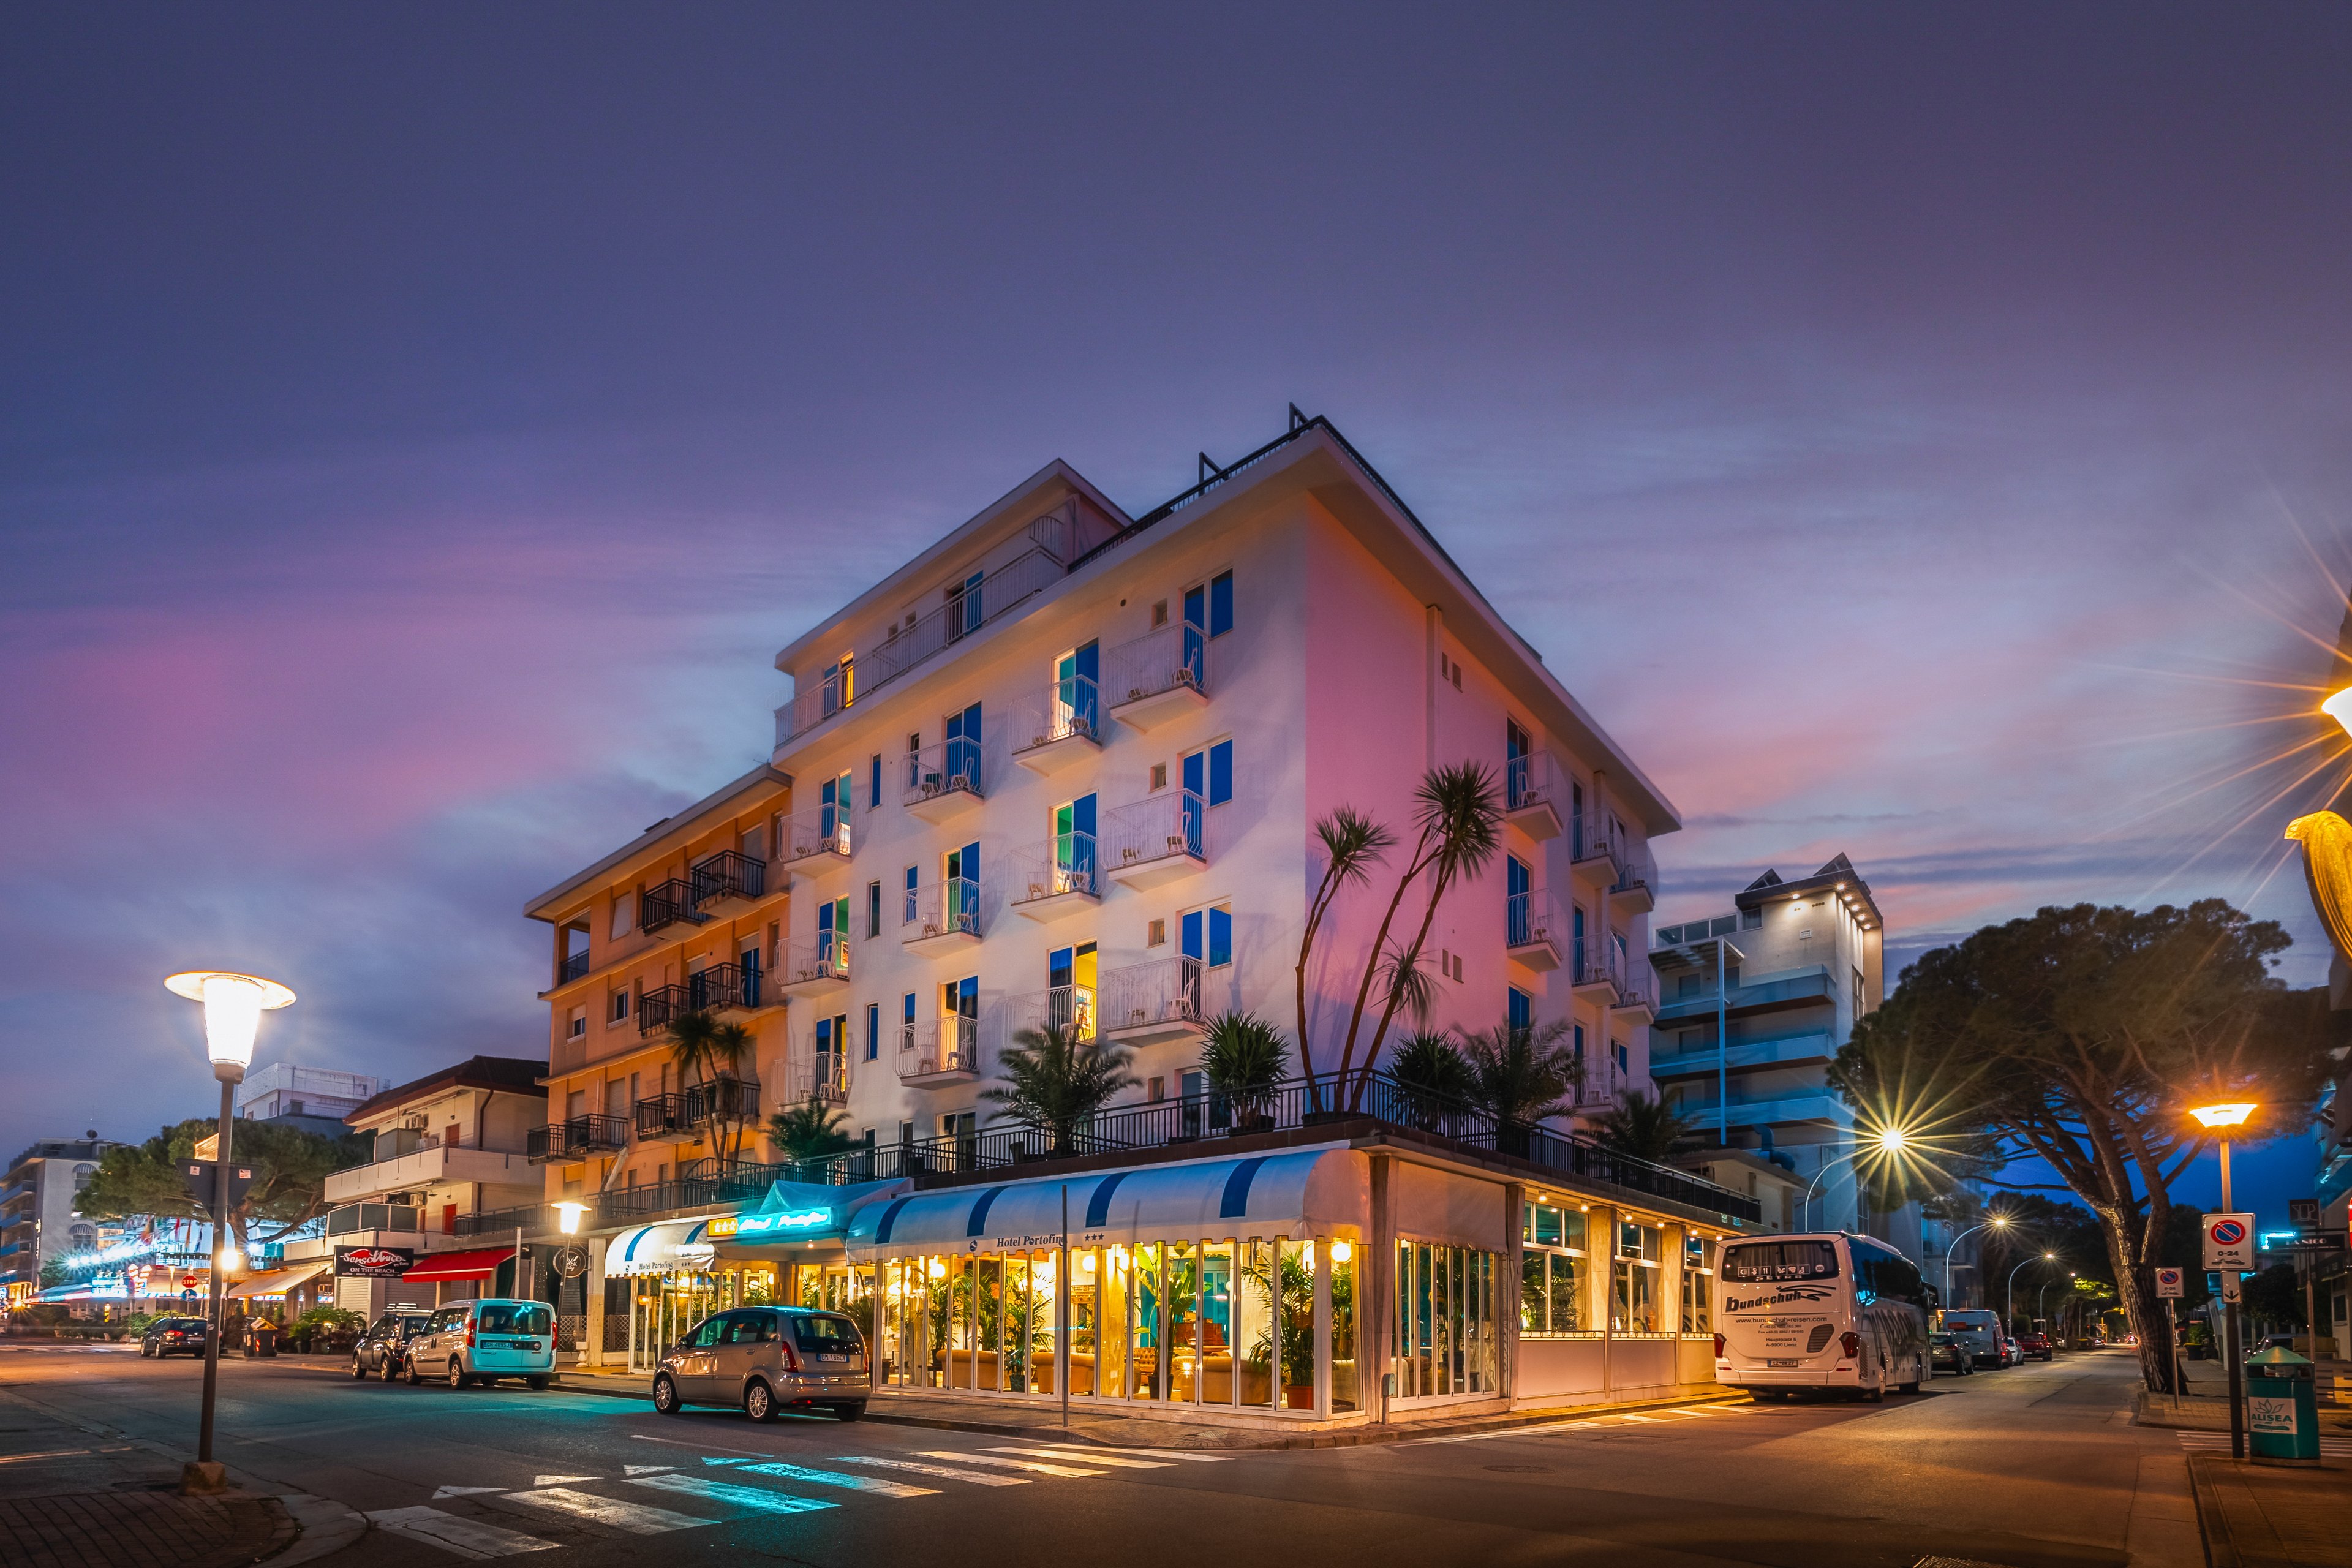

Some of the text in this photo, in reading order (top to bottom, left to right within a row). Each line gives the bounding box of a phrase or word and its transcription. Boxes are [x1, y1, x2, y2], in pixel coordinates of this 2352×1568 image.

[997, 1234, 1064, 1247] Hotel Portofin
[652, 1261, 674, 1270] Portofino
[1725, 1290, 1802, 1313] bundschuh
[2251, 1414, 2293, 1422] ALISEA
